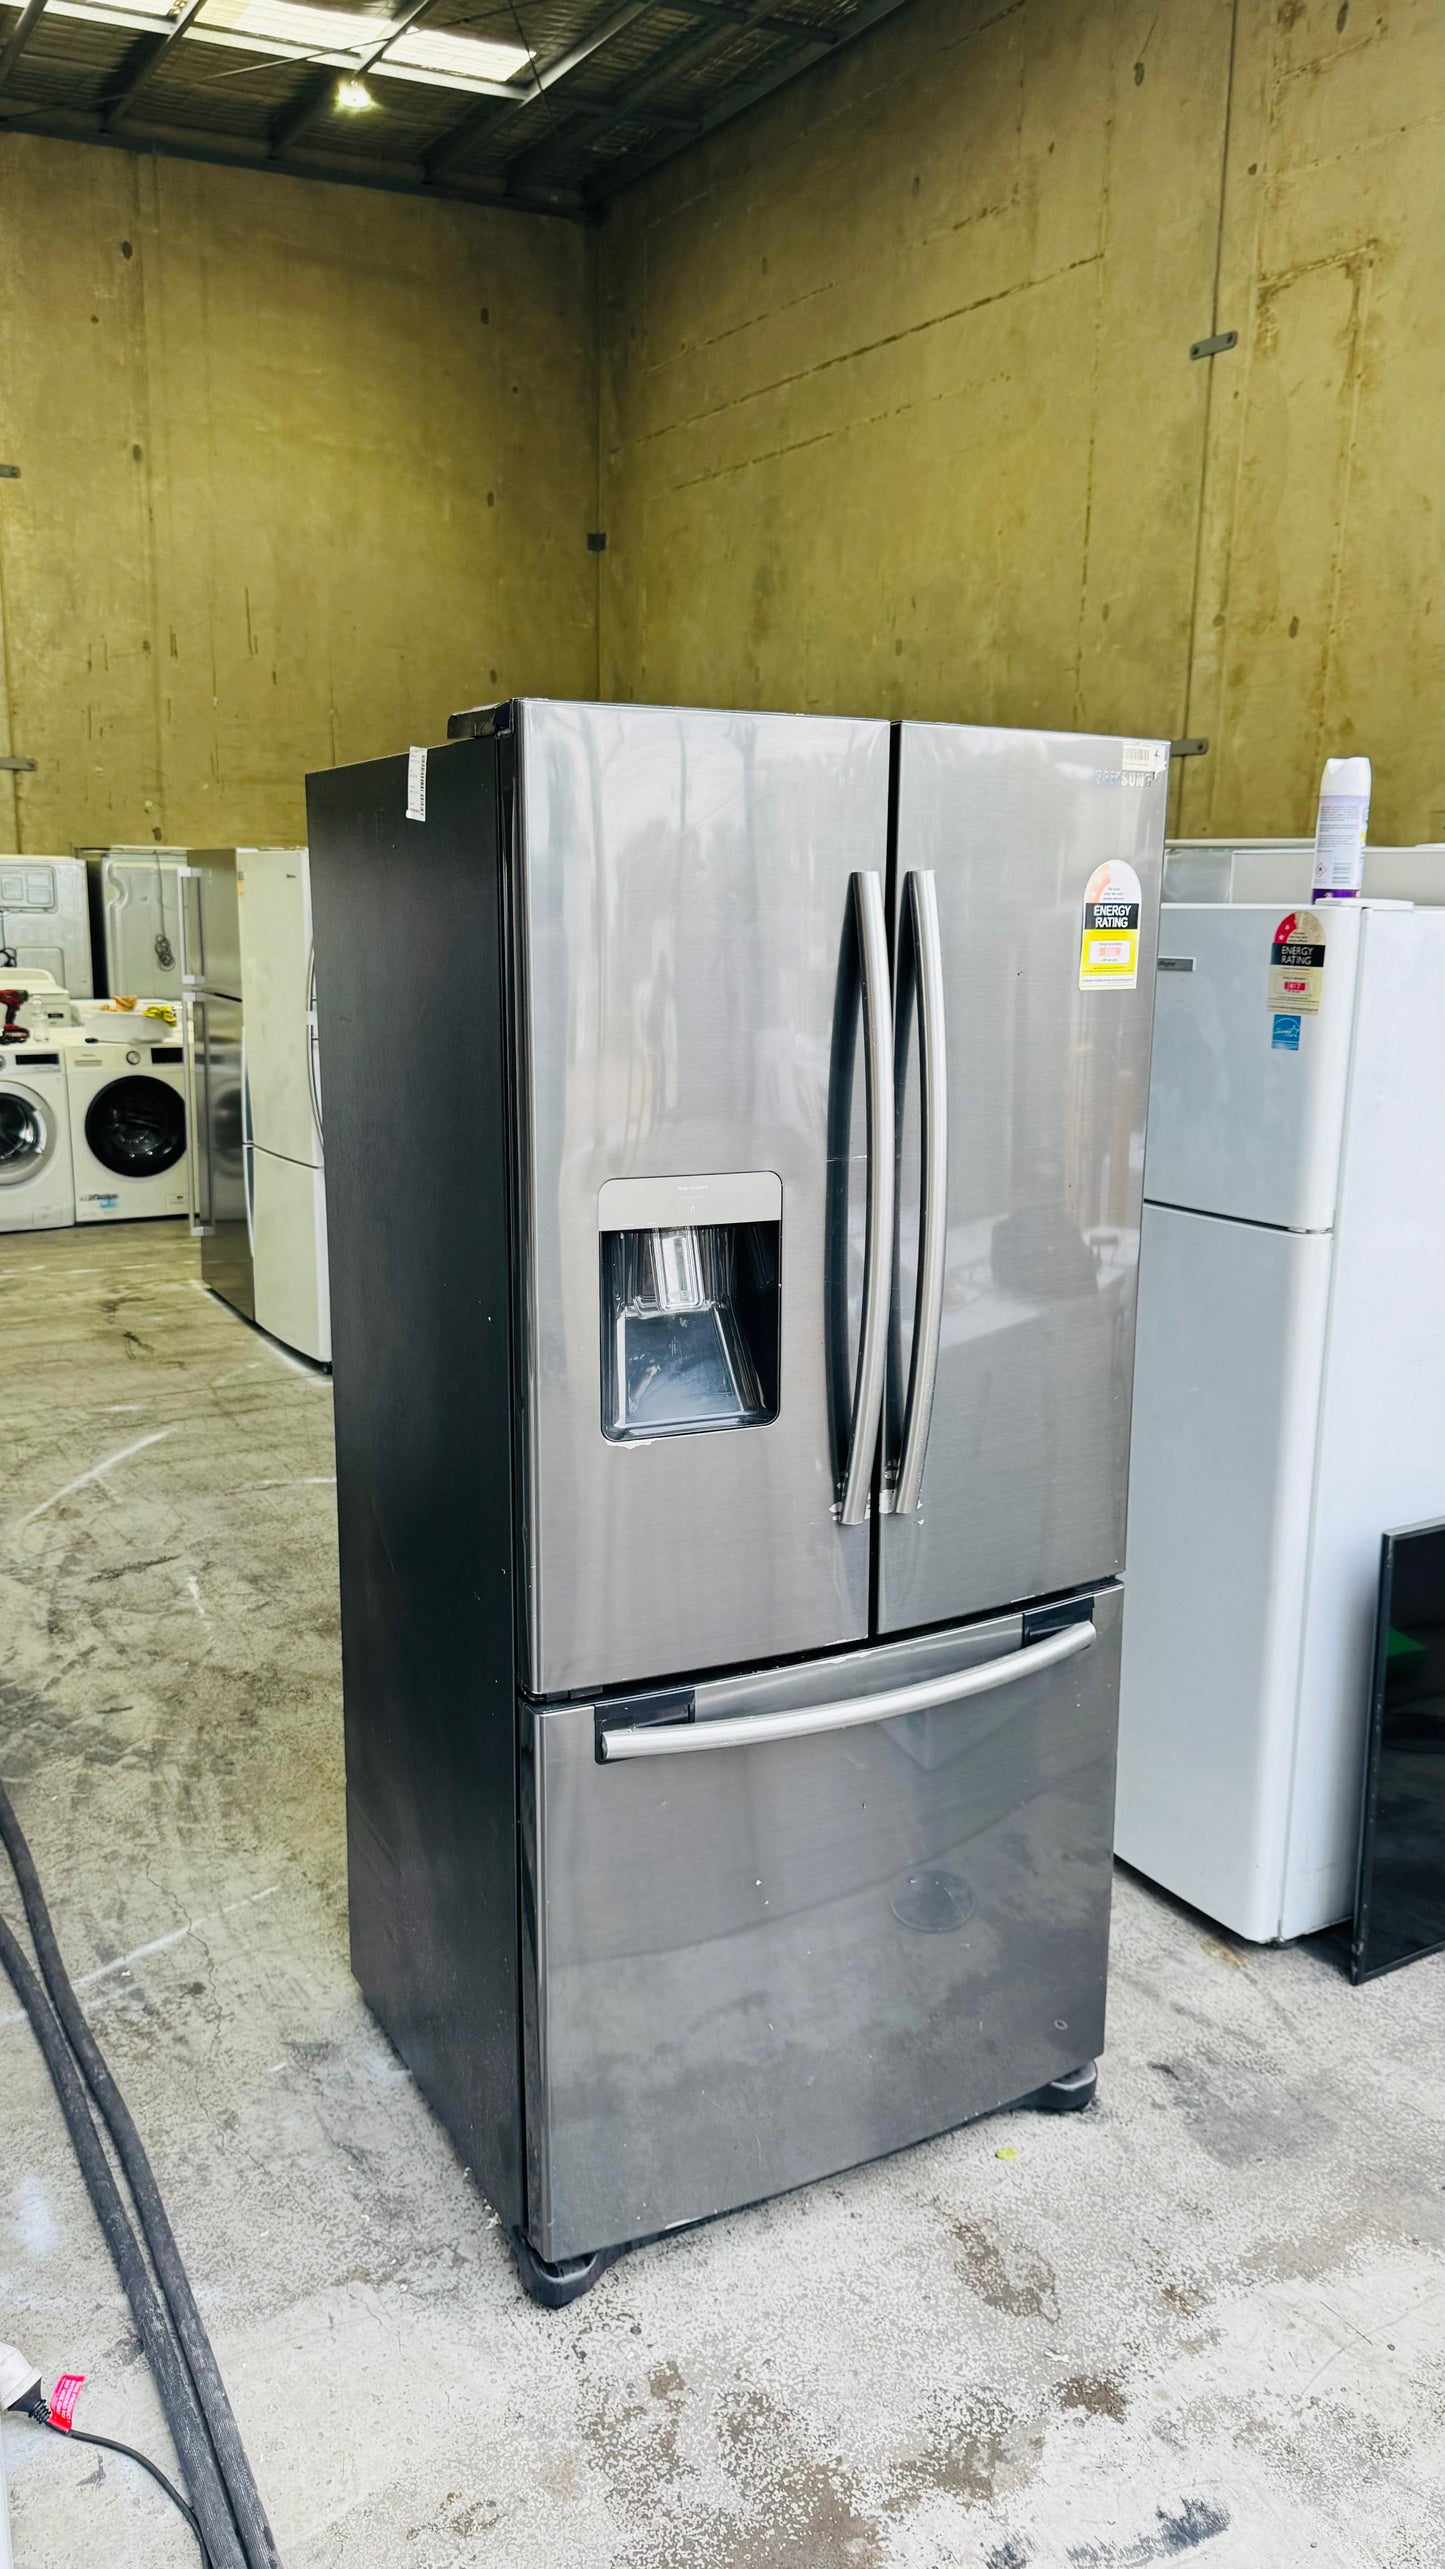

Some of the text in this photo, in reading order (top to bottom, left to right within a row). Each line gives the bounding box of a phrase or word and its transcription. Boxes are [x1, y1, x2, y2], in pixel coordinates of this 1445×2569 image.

[1093, 904, 1132, 917] ENERGY
[1095, 916, 1129, 928] RATING
[1281, 945, 1314, 956] ENERGY
[1281, 955, 1312, 965] RATING
